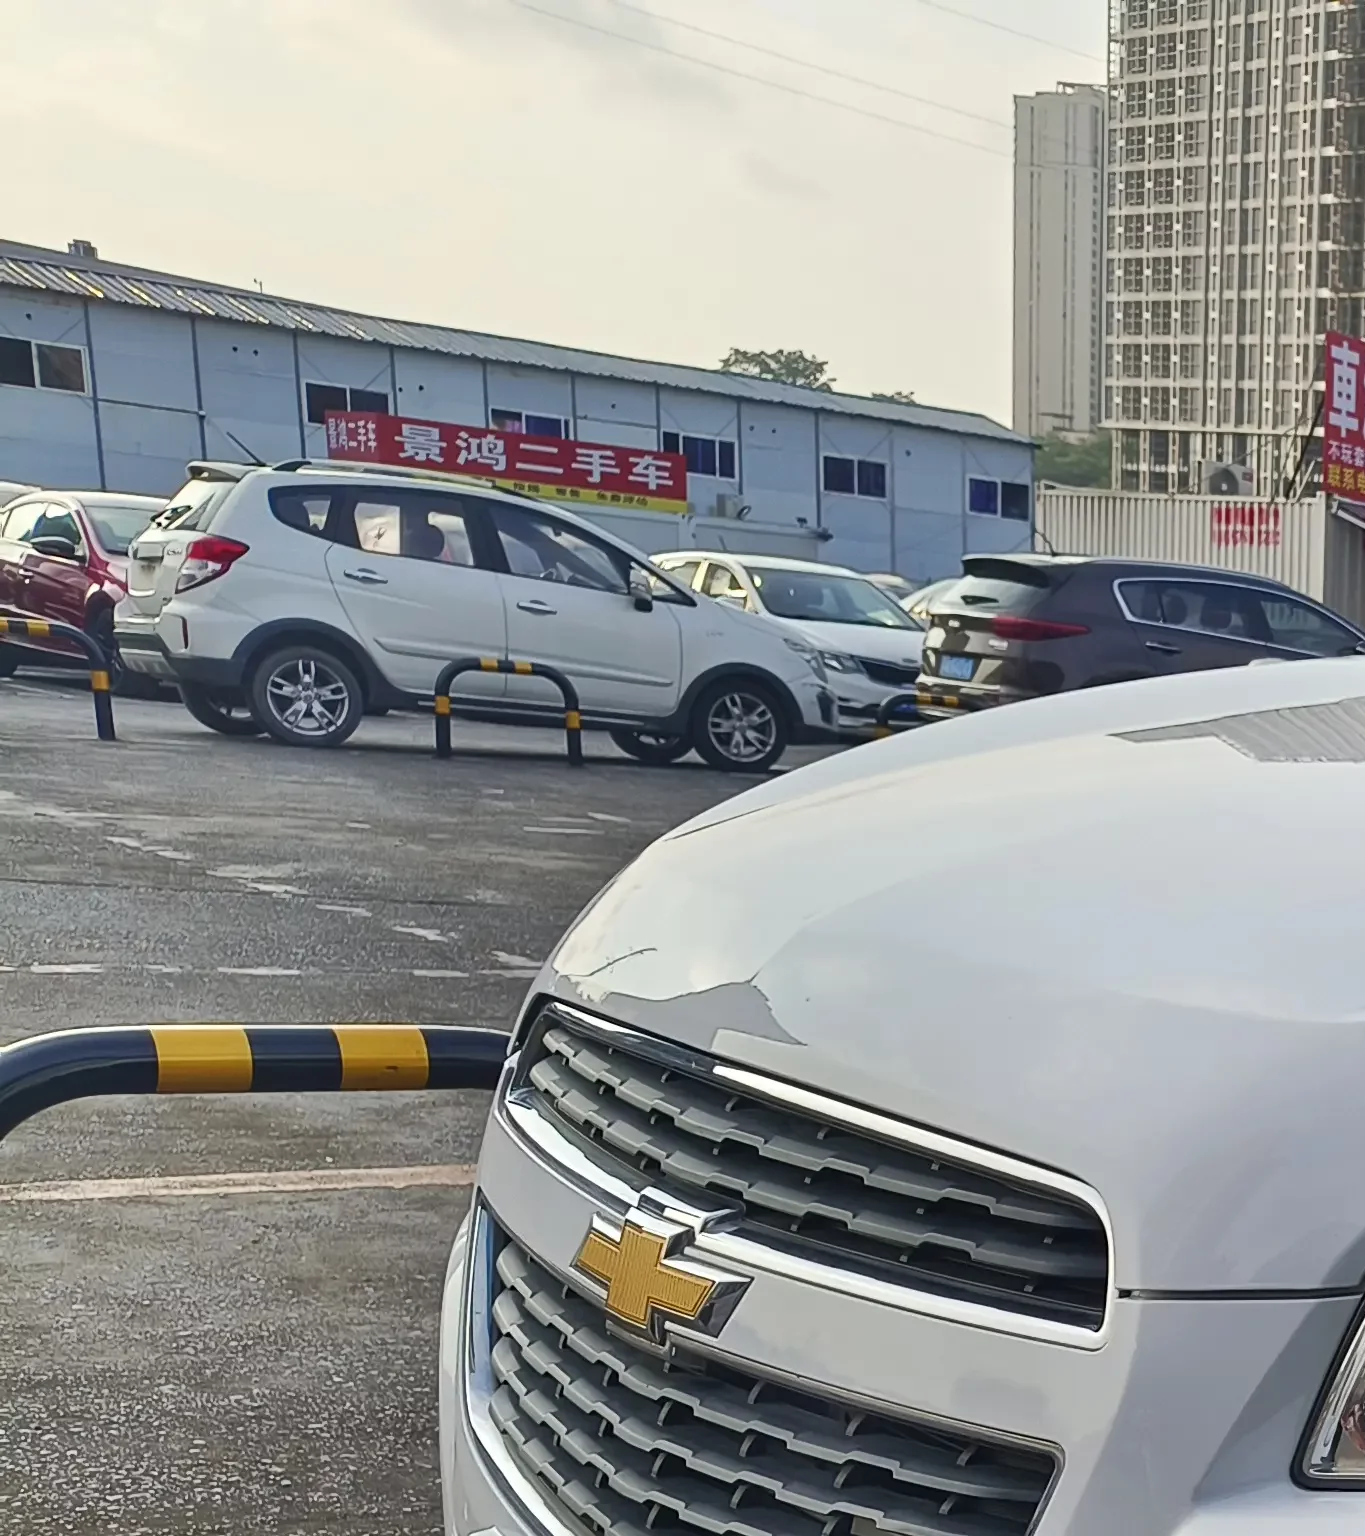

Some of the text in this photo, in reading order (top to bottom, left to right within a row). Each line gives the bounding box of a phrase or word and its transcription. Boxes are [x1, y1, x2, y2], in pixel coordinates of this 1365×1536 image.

[394, 423, 674, 491] 景鸿二手车
